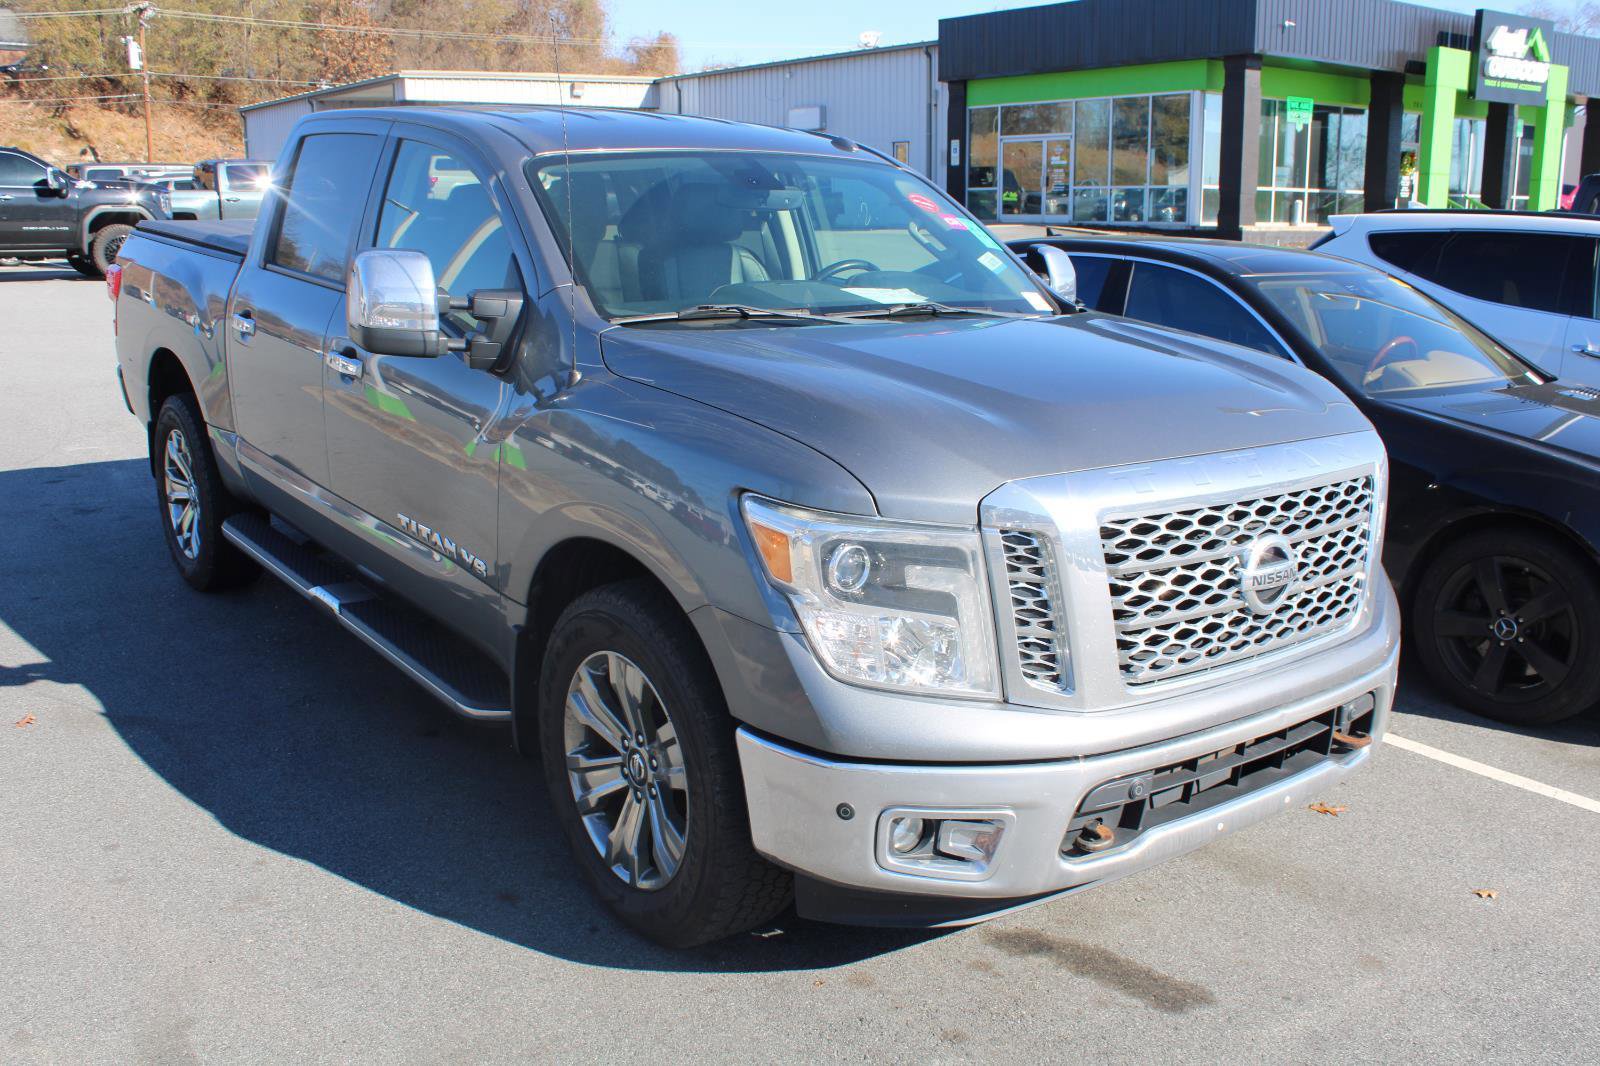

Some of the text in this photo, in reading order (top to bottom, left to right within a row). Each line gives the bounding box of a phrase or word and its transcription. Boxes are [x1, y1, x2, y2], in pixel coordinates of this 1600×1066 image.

[397, 513, 488, 578] TITAN V8
[1251, 566, 1297, 587] NISSAN
